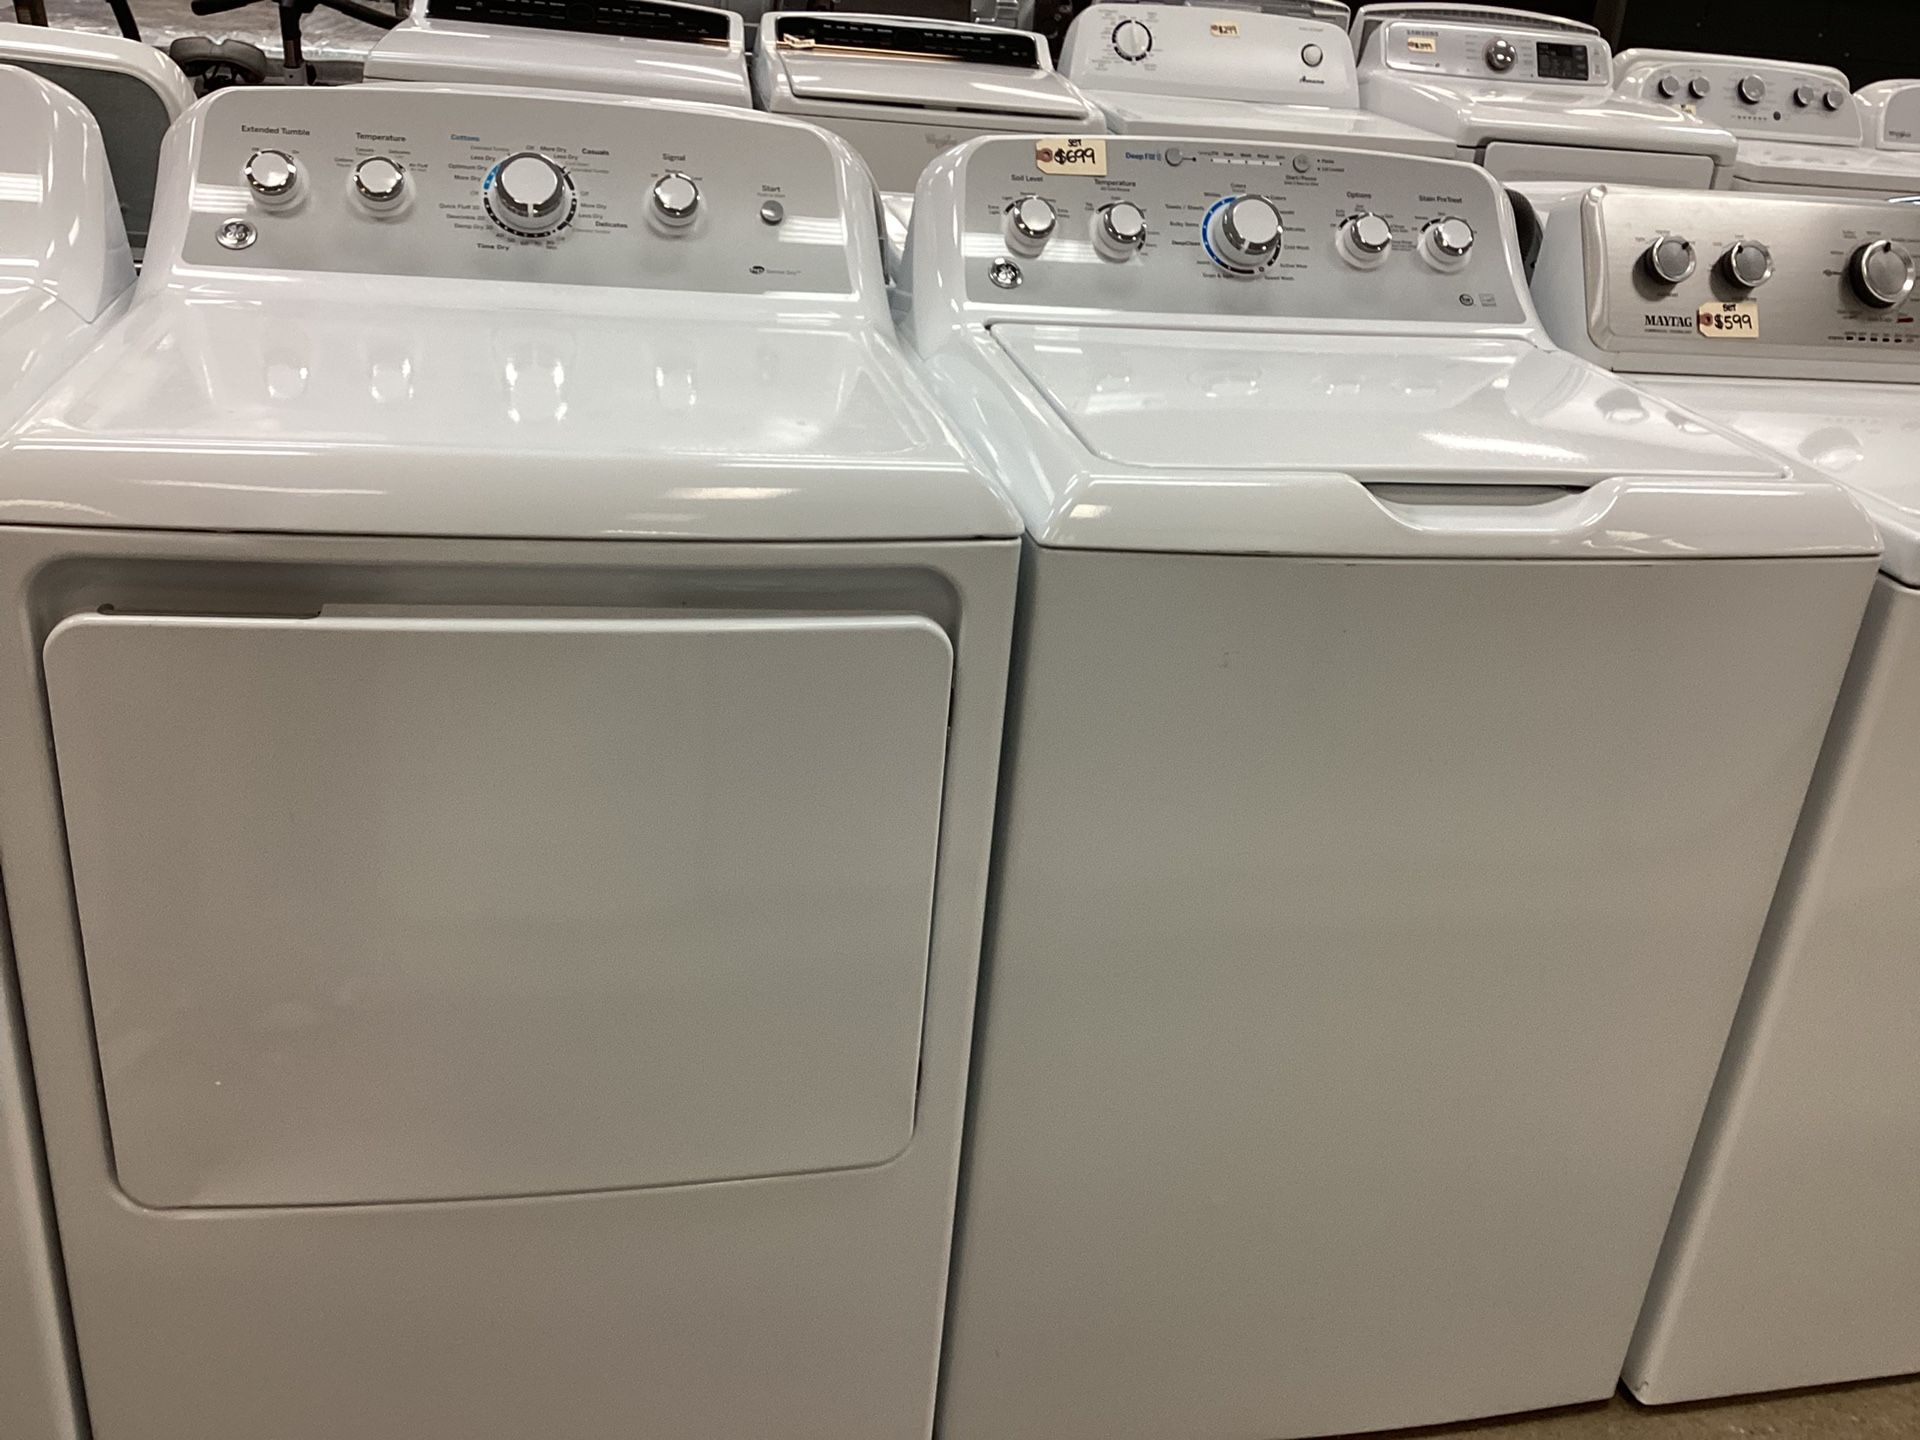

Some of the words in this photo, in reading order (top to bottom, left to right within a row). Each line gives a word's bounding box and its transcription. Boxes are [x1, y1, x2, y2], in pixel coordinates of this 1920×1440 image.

[241, 125, 280, 134] Extended
[281, 128, 310, 136] Tumble
[356, 132, 406, 142] Temperature
[1068, 138, 1082, 147] SET
[662, 153, 686, 162] Signal
[1054, 148, 1096, 164] $699
[1011, 174, 1025, 182] Soil
[1094, 179, 1136, 187] Temperature
[762, 184, 781, 192] Start
[1437, 195, 1462, 204] PreTreat
[1723, 304, 1737, 312] SET
[1645, 315, 1692, 327] MAYTAG
[1714, 314, 1752, 330] $599
